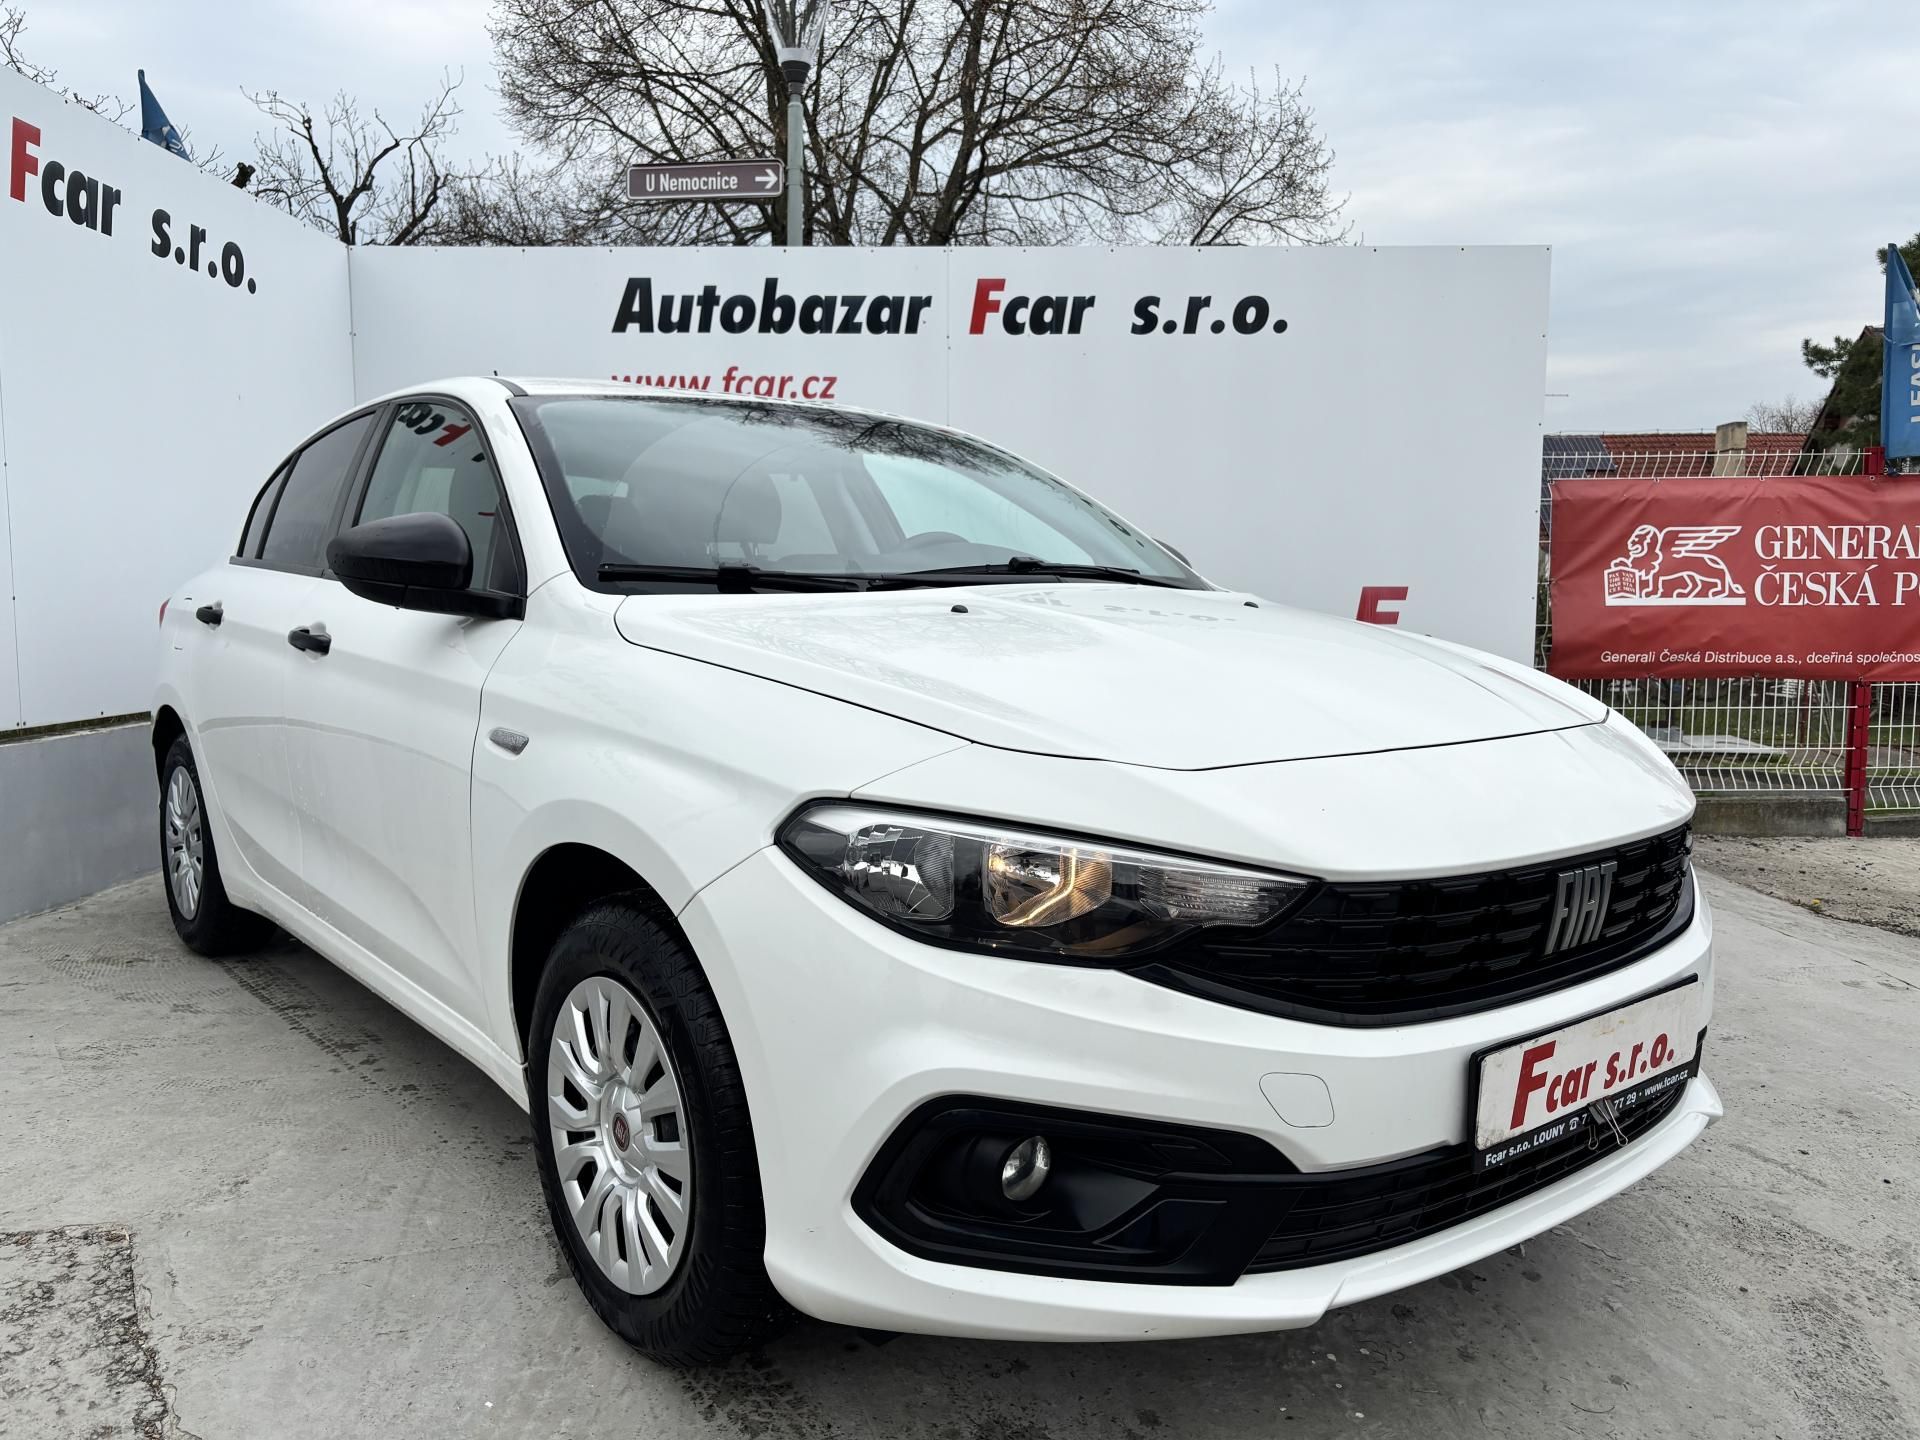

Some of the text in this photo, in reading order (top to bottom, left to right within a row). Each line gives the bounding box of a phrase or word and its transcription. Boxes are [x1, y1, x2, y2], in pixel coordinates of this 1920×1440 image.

[10, 116, 257, 294] Fcar s.r.o.
[645, 171, 738, 192] U Nemocnice
[611, 277, 1290, 336] Autobazar Fcar s.r.o.
[1754, 524, 1920, 559] GENERA
[1754, 564, 1920, 606] ČESKÁ P
[1600, 651, 1655, 663] Generali
[1659, 648, 1701, 663] Česká
[1704, 651, 1771, 663] Distribuce
[1775, 653, 1802, 665] a.s.,
[1806, 651, 1852, 663] dceřiná
[1544, 861, 1618, 955] FIAT
[1510, 1033, 1675, 1130] Fcar s.r.o.
[1485, 1149, 1507, 1166] Fcar
[1508, 1141, 1531, 1156] s.r.o.
[1533, 1123, 1566, 1146] LOUNY
[1625, 1091, 1637, 1105] 29
[1644, 1069, 1688, 1097] www.fcar.cz
